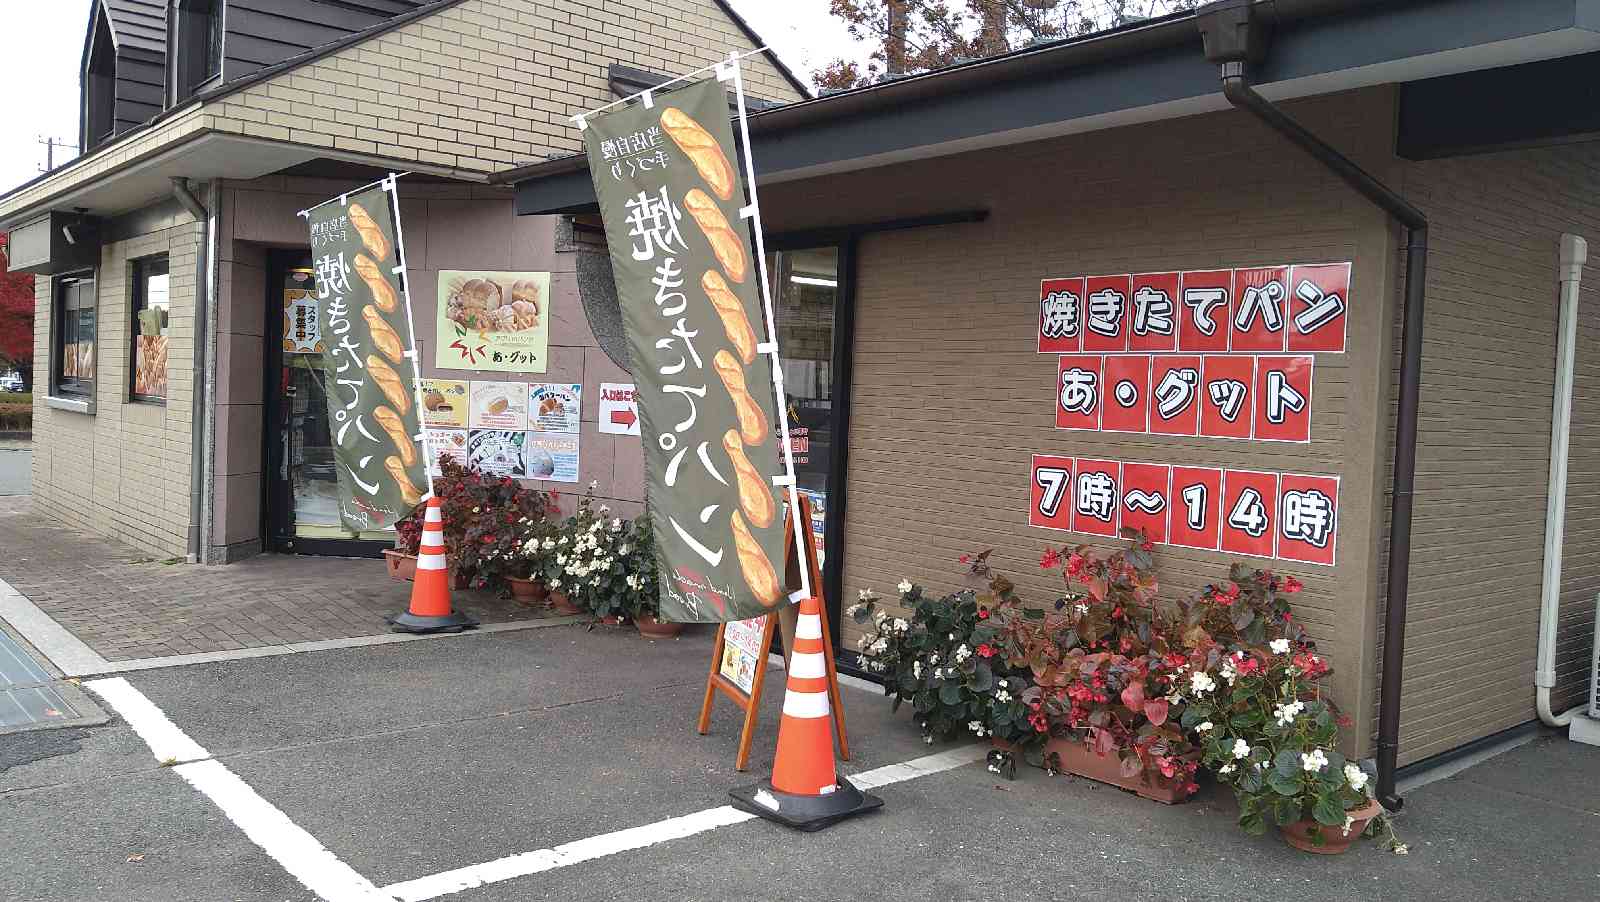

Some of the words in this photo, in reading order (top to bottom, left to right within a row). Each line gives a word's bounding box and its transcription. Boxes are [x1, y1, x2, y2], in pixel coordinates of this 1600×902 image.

[307, 306, 316, 341] スタッフ
[1042, 281, 1344, 337] 焼きたてパン
[1060, 368, 1305, 423] あ・グット
